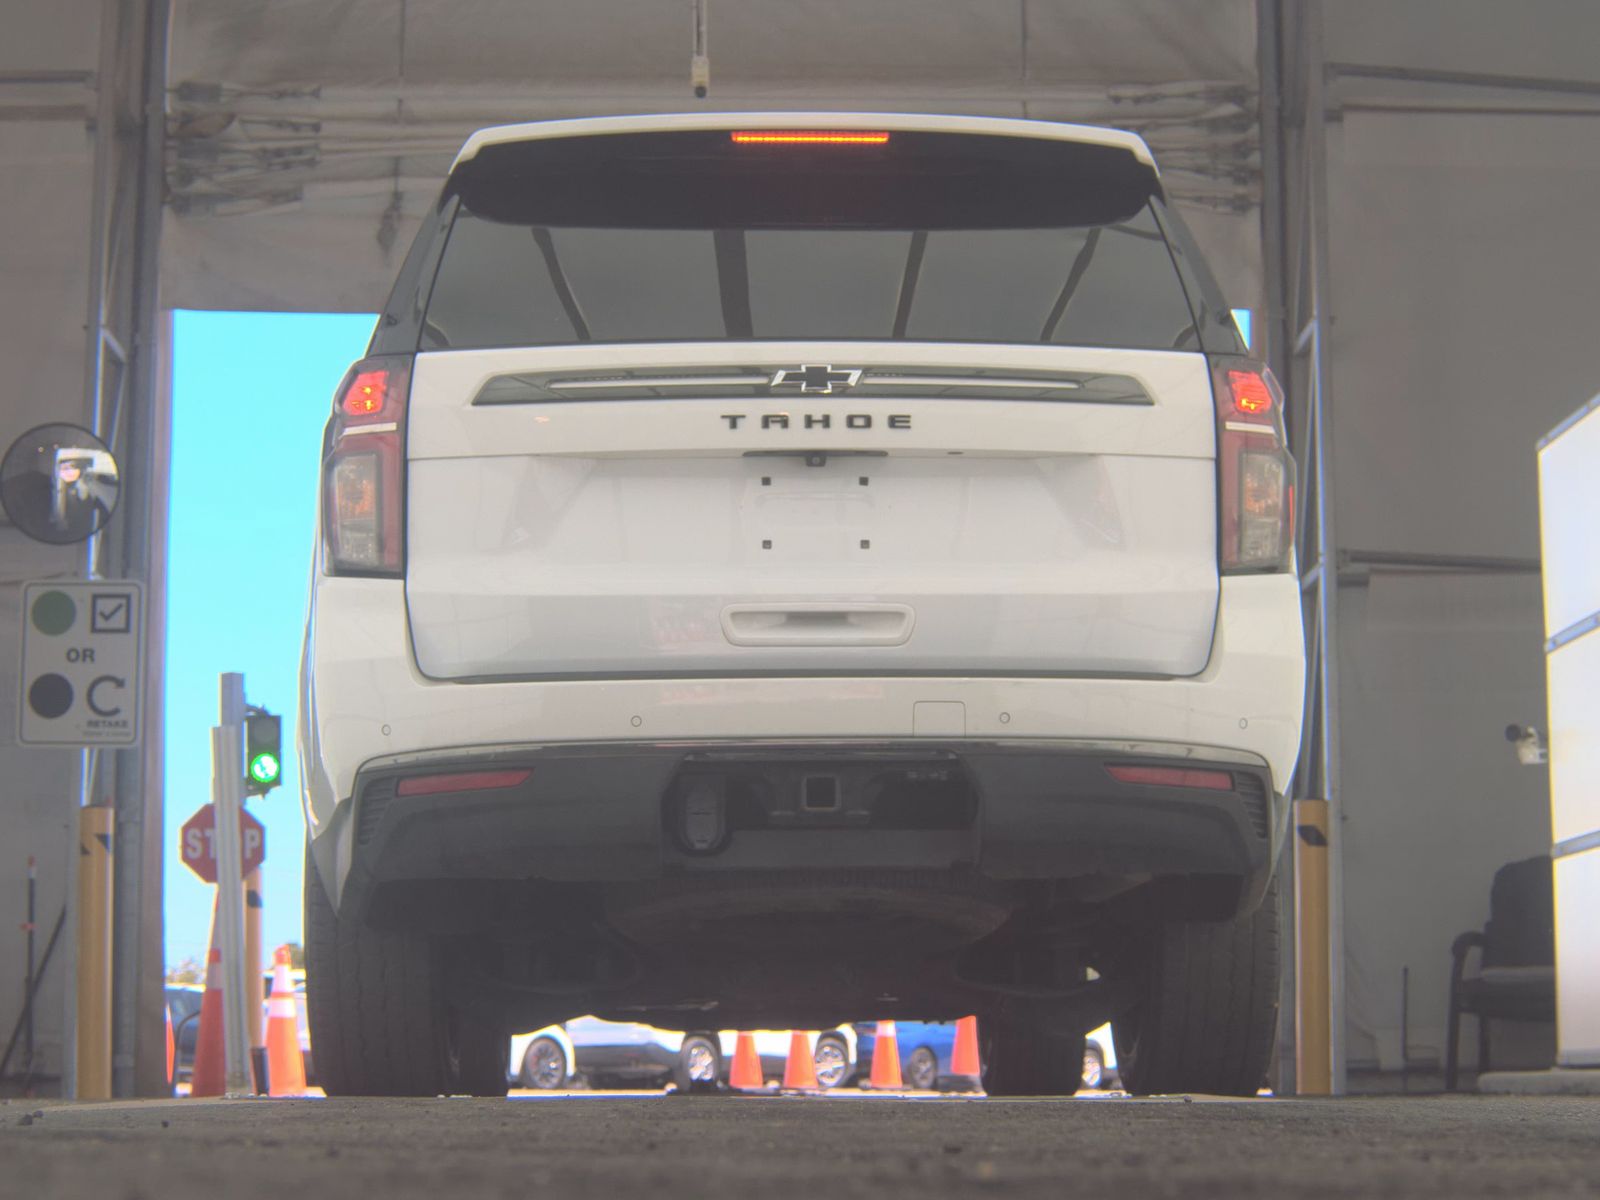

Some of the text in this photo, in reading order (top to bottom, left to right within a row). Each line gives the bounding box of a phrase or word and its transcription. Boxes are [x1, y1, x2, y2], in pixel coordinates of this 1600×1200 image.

[720, 414, 912, 430] TAHOE
[66, 649, 96, 663] OR
[185, 827, 261, 860] STP
